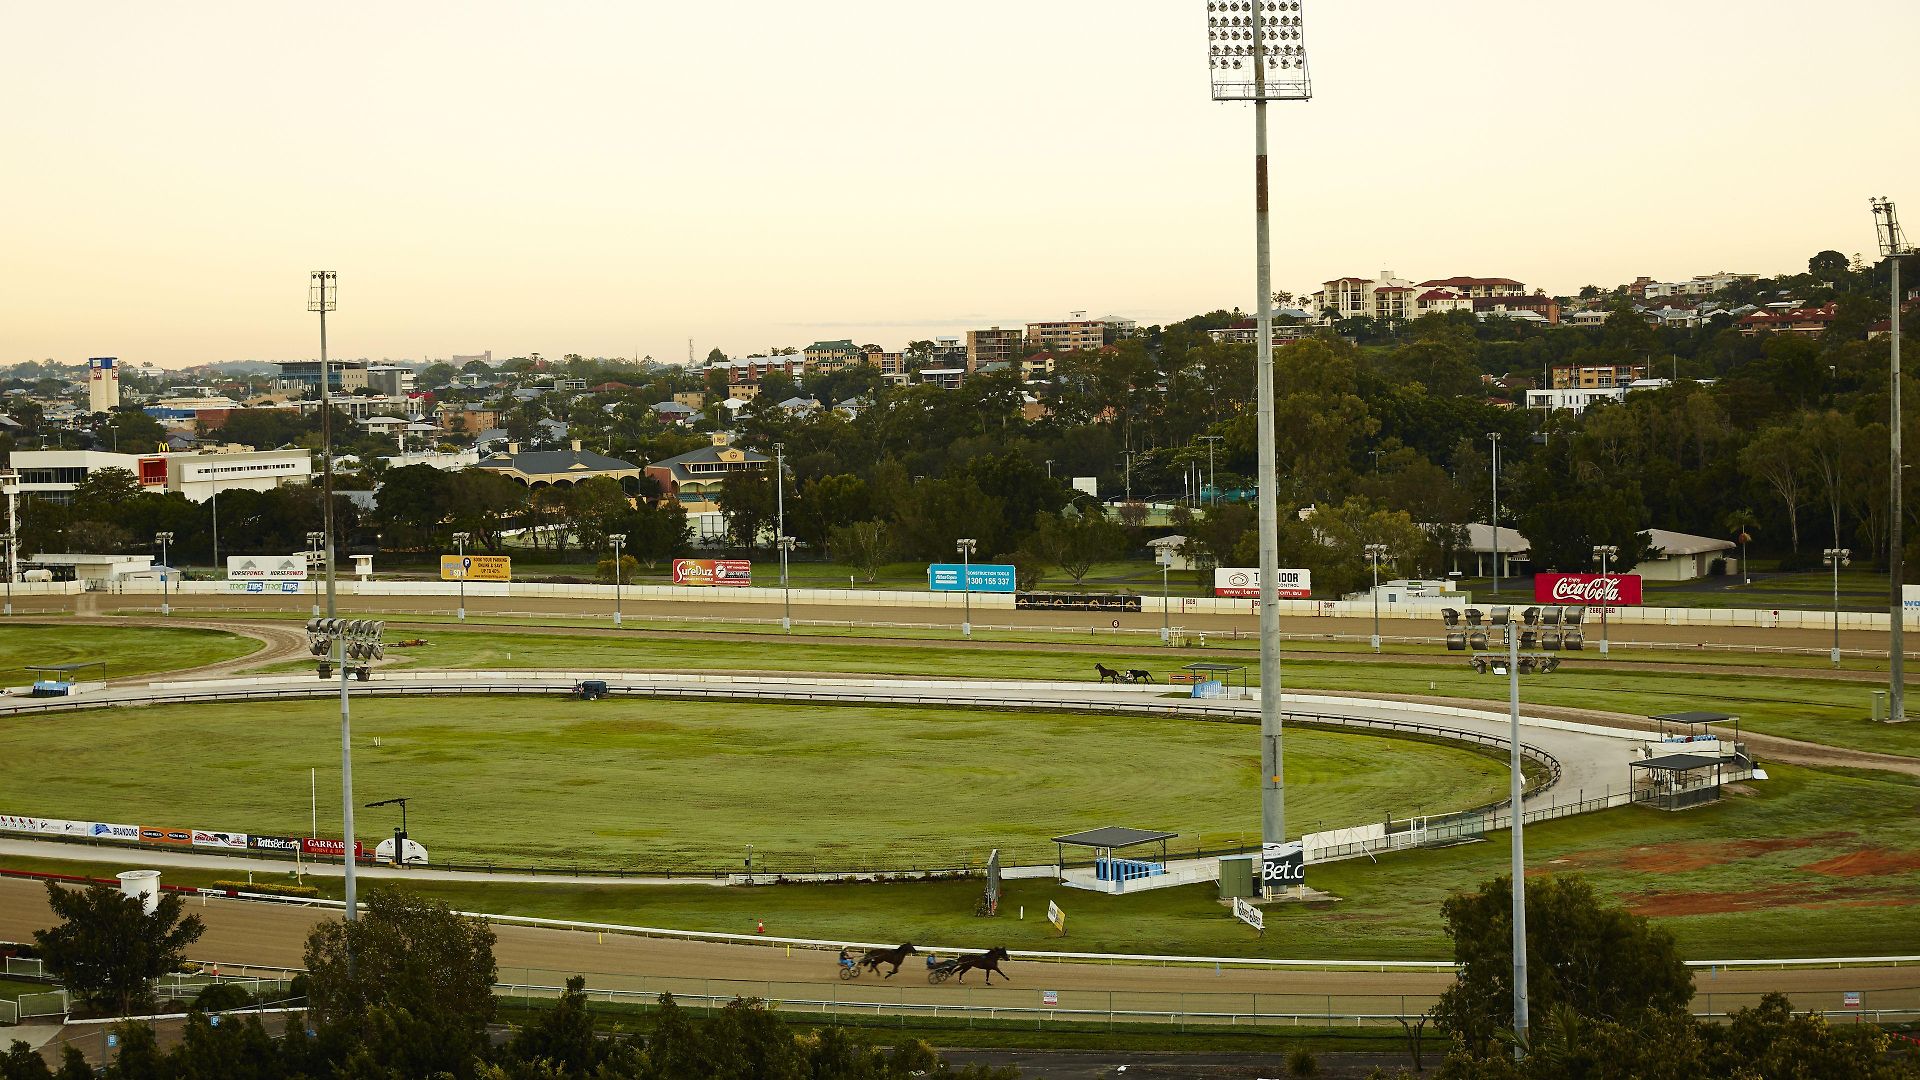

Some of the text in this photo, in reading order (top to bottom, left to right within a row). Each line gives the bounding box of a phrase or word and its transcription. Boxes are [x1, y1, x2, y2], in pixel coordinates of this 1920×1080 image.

[968, 577, 983, 585] 1300
[1254, 573, 1299, 583] TIDOR
[113, 827, 138, 837] BRANDONS
[307, 839, 358, 850] GARRARS
